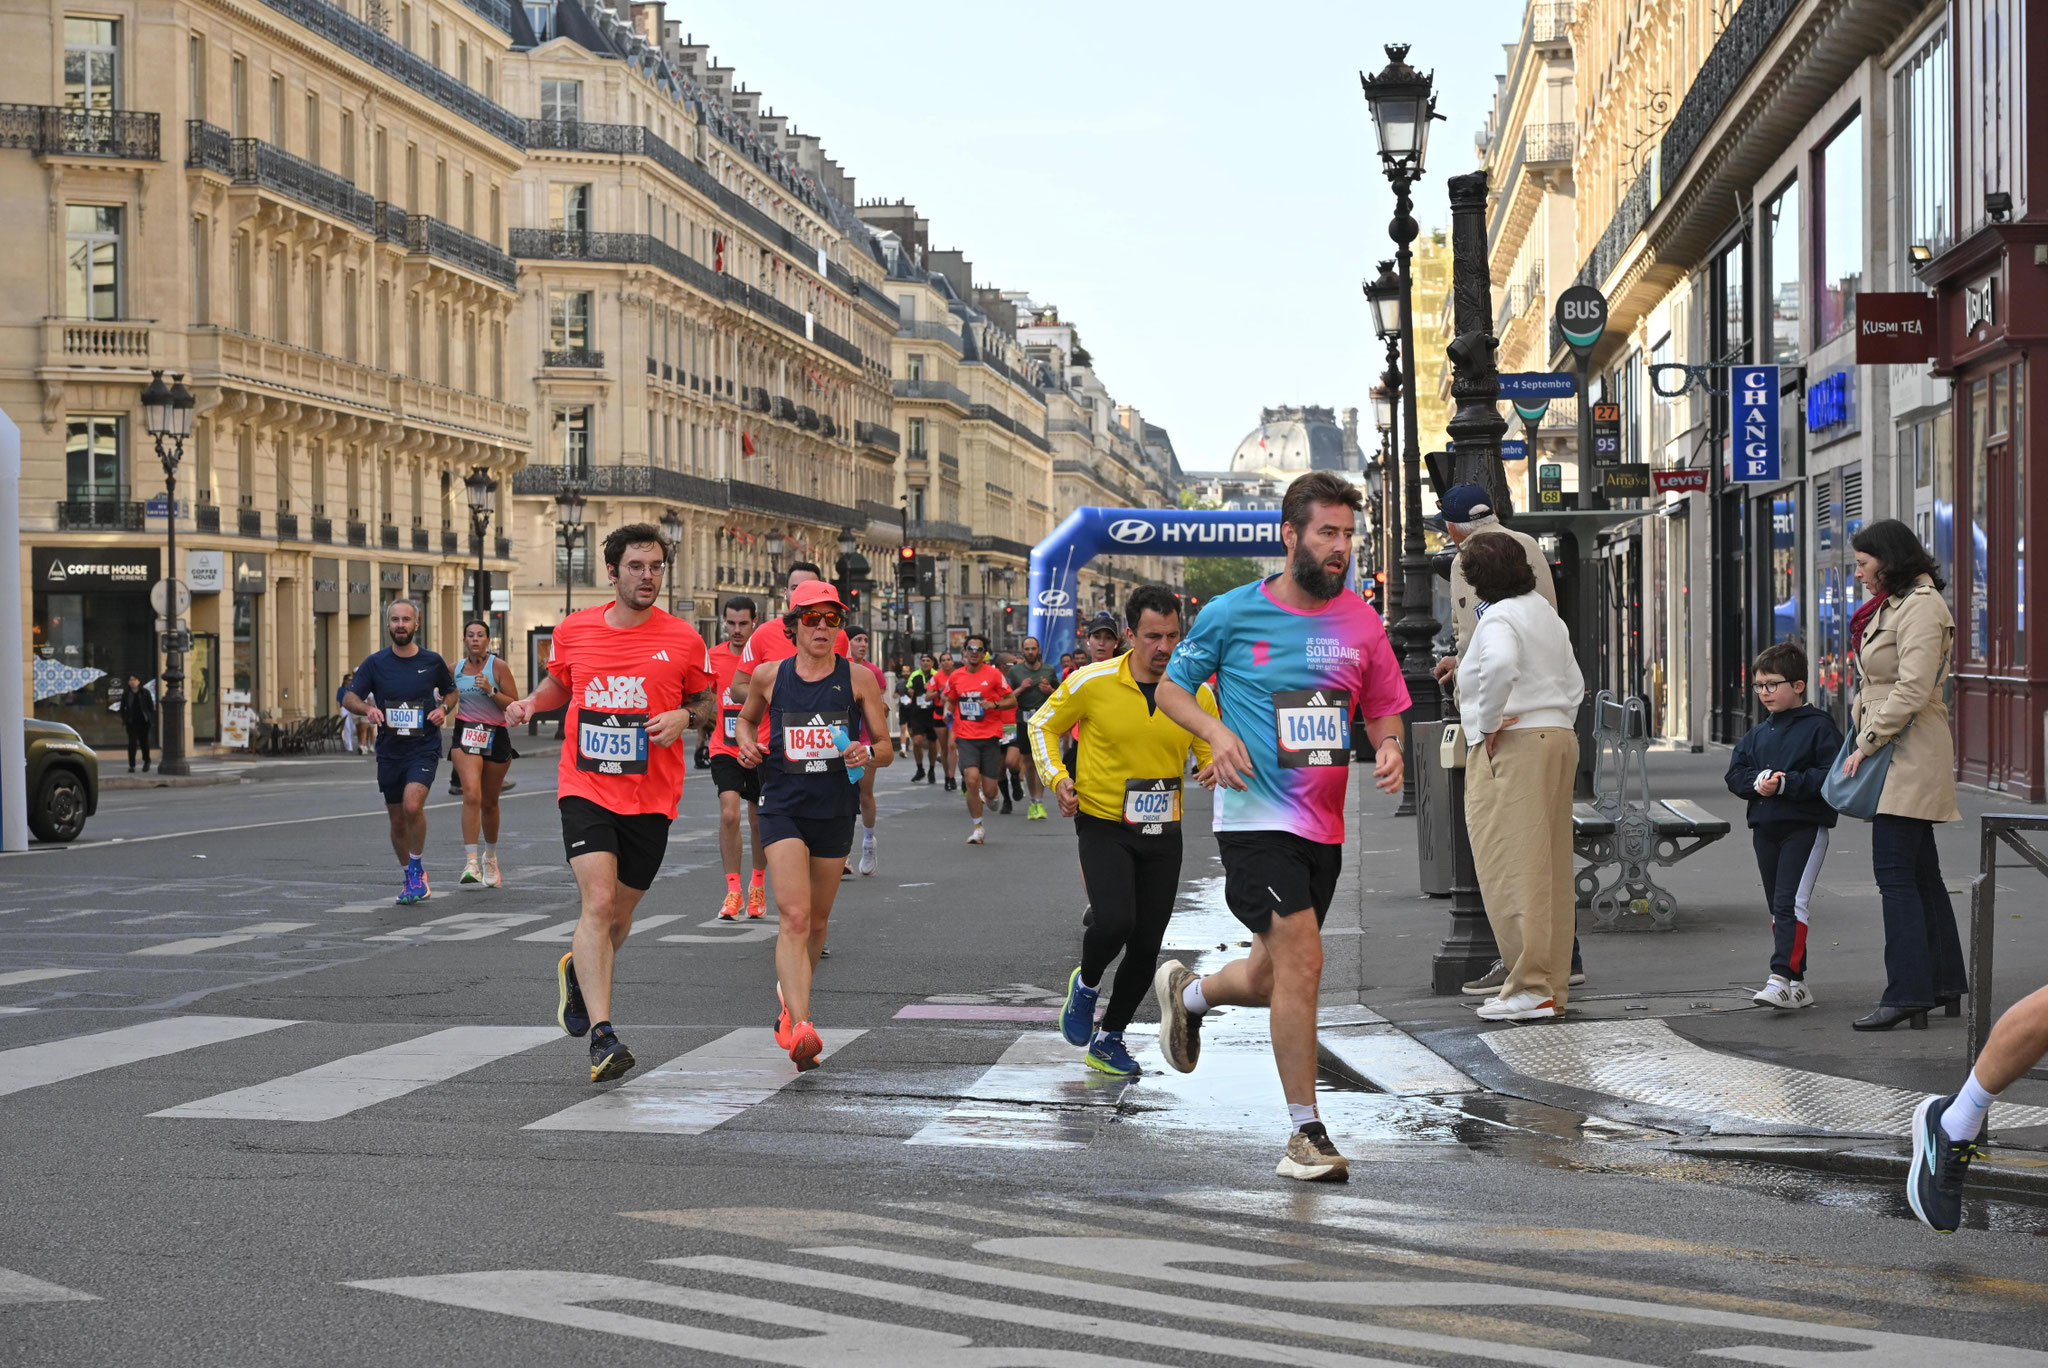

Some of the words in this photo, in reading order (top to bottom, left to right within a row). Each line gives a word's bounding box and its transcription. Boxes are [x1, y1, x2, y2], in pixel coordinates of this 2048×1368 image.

[1564, 300, 1600, 320] BUS
[1862, 319, 1898, 336] KUSMI
[1901, 319, 1923, 335] TEA
[1512, 380, 1519, 389] 4
[1521, 379, 1571, 391] Septembre
[1597, 406, 1615, 419] 27
[1743, 372, 1768, 476] CHANGE
[1597, 438, 1616, 451] 95
[1544, 467, 1557, 477] 21
[1606, 472, 1648, 487] Amaya
[1543, 491, 1558, 502] 68
[1162, 523, 1281, 542] HYUNDAI
[67, 564, 110, 575] COFFEE
[111, 564, 148, 576] HOUSE
[1032, 607, 1074, 617] HYUNDAI
[1305, 637, 1315, 645] JE
[1315, 638, 1340, 646] COURS
[1305, 645, 1360, 661] SOLIDAIRE
[606, 675, 647, 693] 10K
[584, 690, 648, 709] PARIS
[961, 702, 977, 712] 14471
[390, 709, 413, 722] 13061
[1287, 715, 1337, 742] 16146
[464, 729, 488, 743] 19368
[585, 730, 631, 755] 16735
[789, 729, 834, 749] 18433
[1317, 750, 1331, 758] 10K
[1308, 756, 1333, 766] PARIS
[599, 766, 623, 774] PARIS
[805, 765, 828, 773] PARIS
[1134, 793, 1170, 813] 6025
